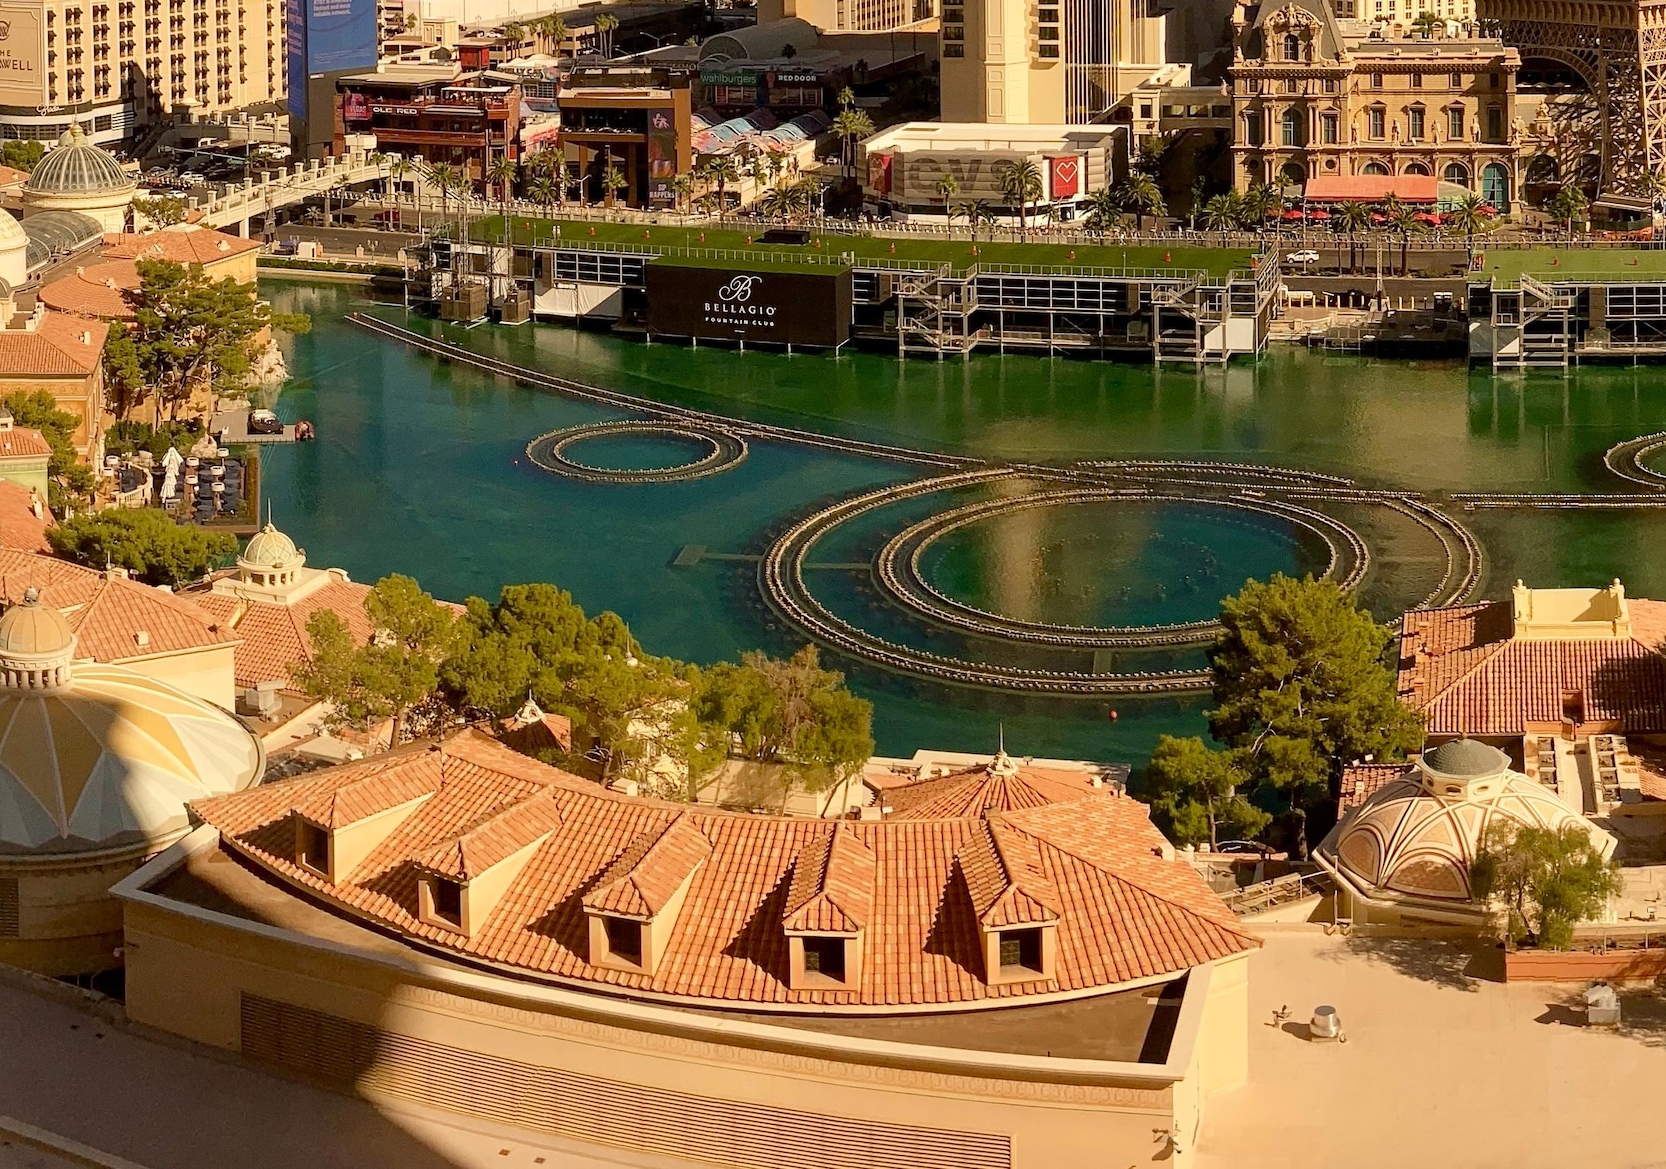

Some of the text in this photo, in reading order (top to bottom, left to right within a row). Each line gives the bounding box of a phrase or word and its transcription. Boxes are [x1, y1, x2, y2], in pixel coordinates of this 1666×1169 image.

[701, 72, 757, 85] wahlburgers
[908, 157, 1018, 193] CVS
[718, 275, 763, 302] B
[704, 302, 775, 316] BELLAGIO
[705, 316, 775, 327] FOUNTAIN CLUB
